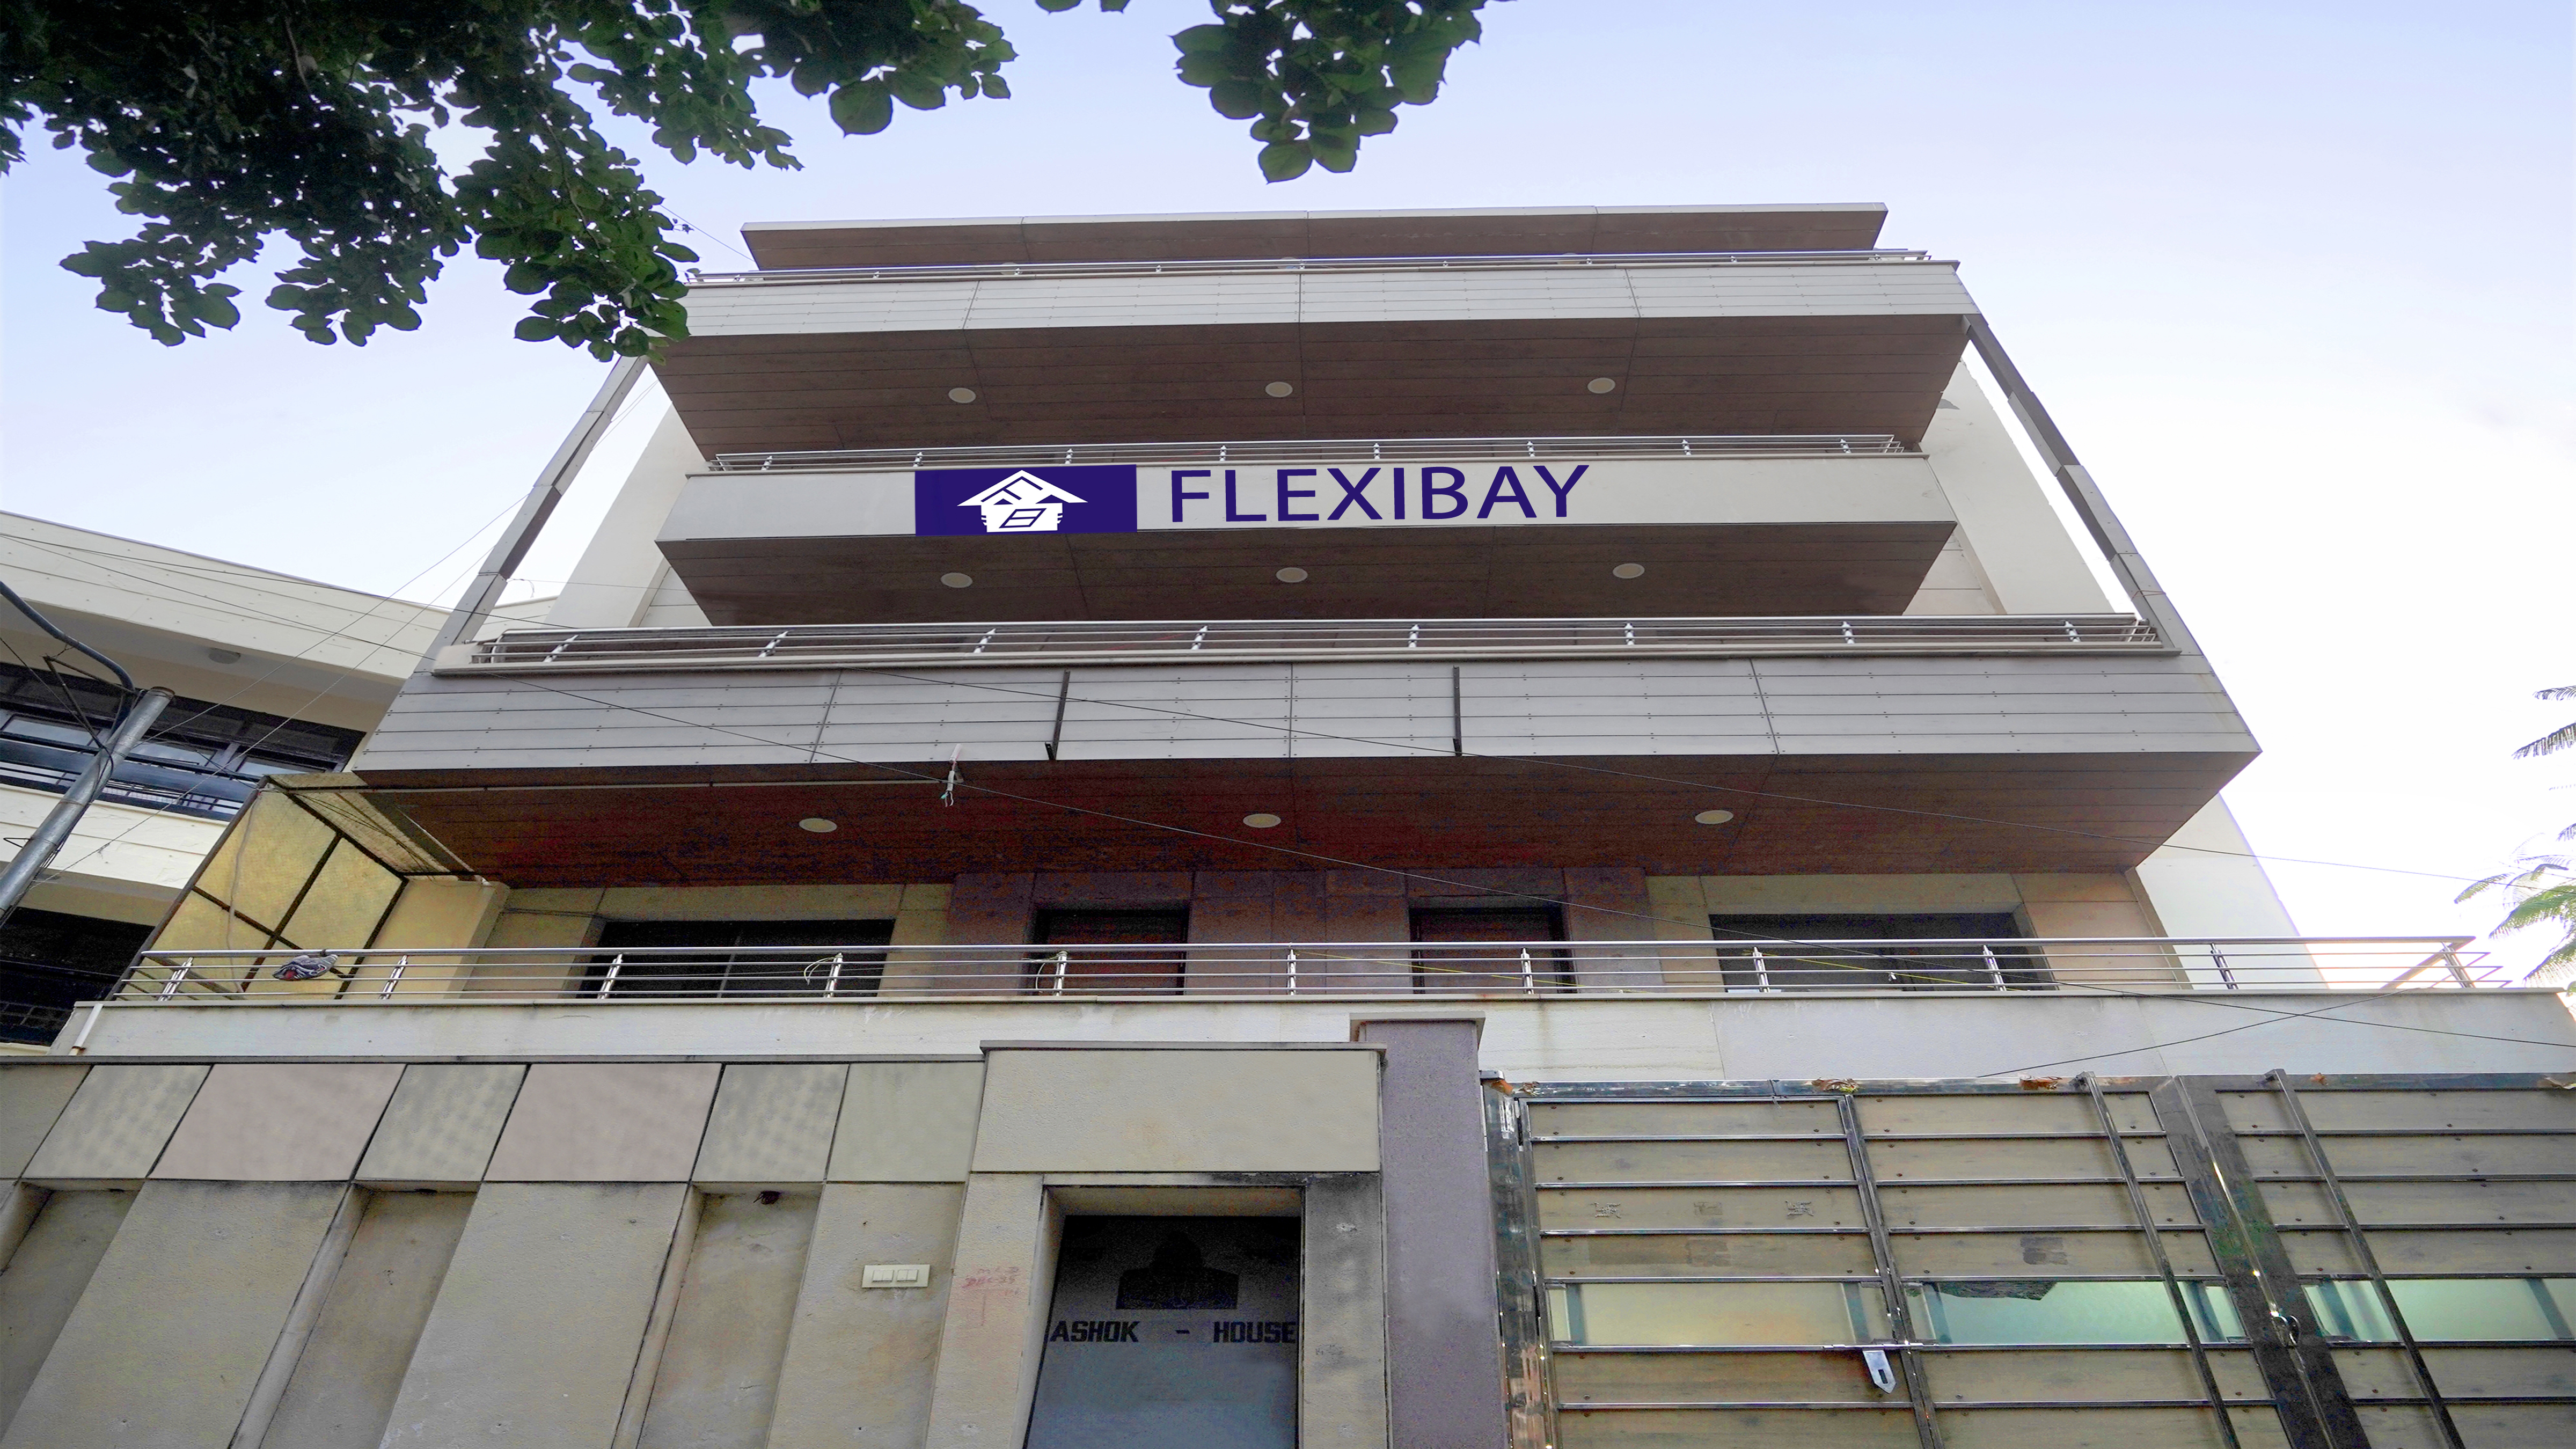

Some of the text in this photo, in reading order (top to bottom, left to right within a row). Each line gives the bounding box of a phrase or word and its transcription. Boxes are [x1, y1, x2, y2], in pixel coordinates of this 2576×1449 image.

[1171, 465, 1589, 522] FLEXIBAY
[1050, 1320, 1140, 1342] ASHOK
[1213, 1321, 1297, 1343] HOUSE
